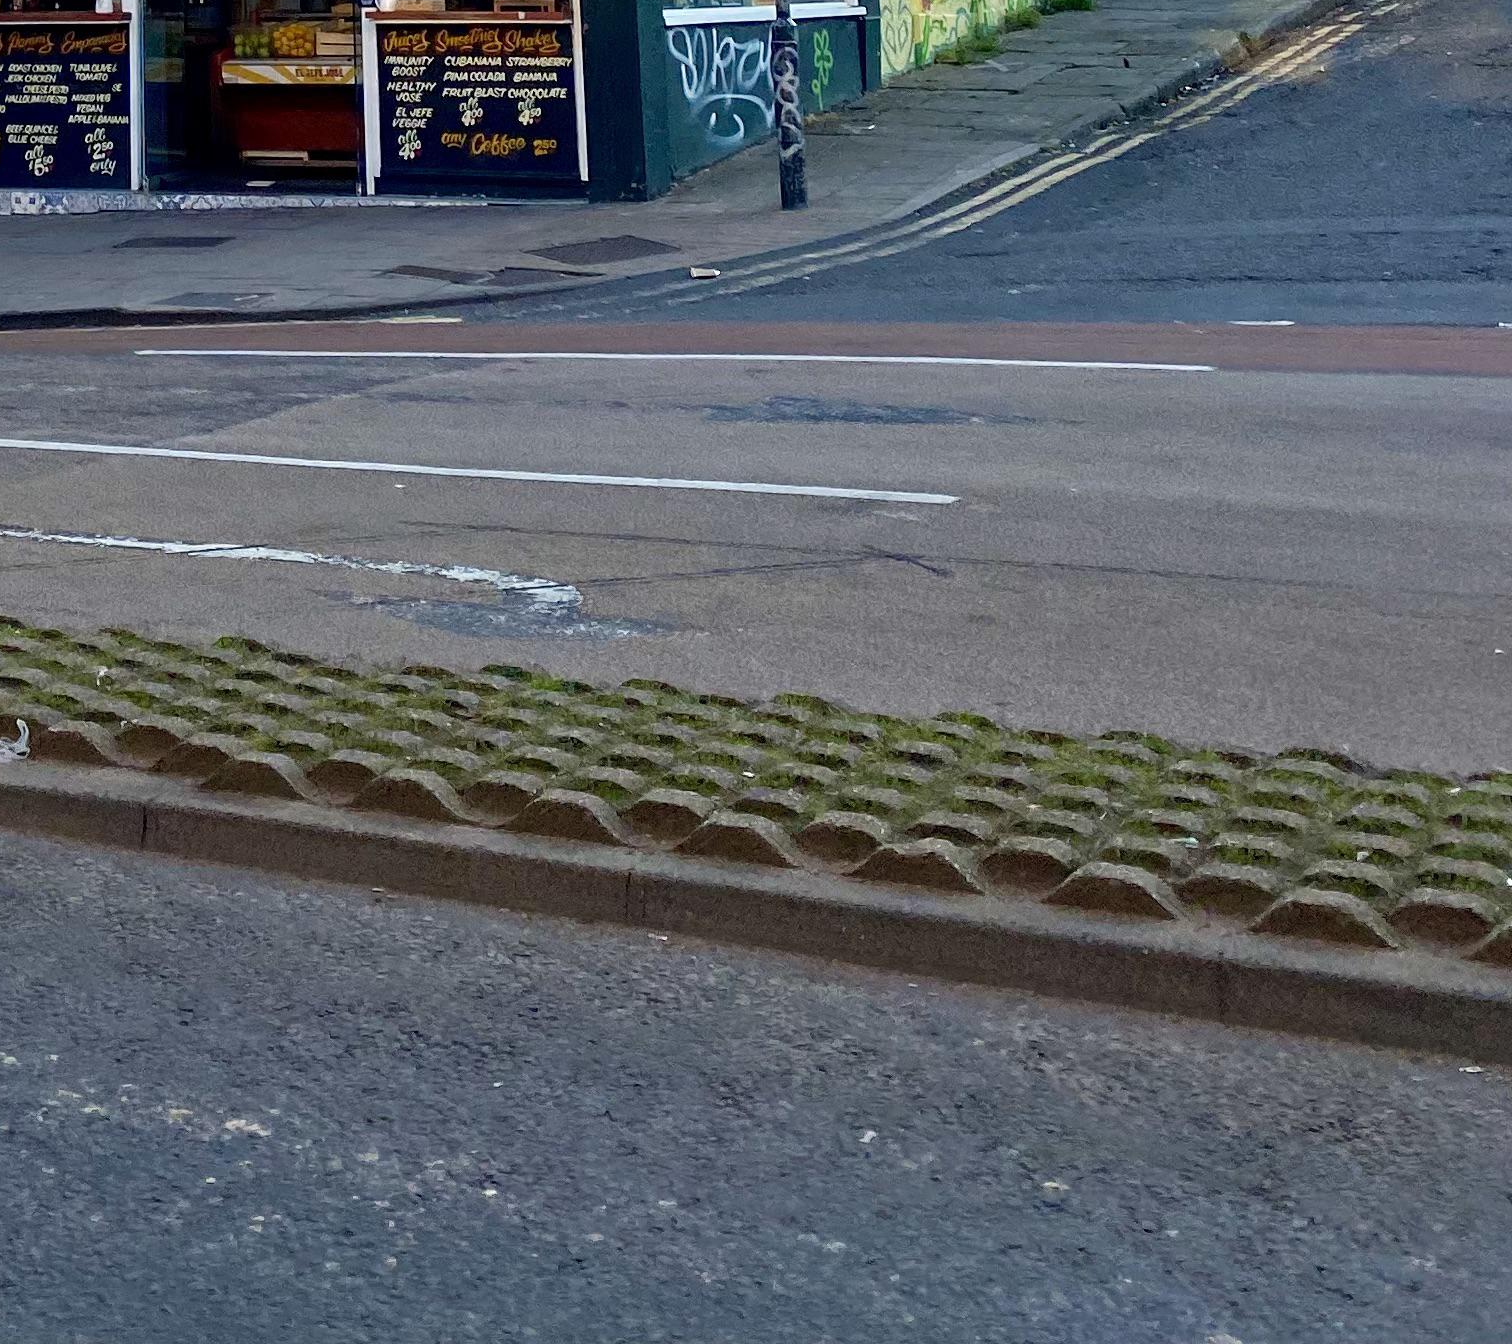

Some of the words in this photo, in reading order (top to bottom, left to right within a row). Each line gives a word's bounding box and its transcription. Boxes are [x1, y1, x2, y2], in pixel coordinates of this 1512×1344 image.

[384, 56, 434, 66] IMMUNITY
[444, 56, 501, 67] CUBANANA
[506, 56, 572, 67] STRAWBERRY
[391, 66, 426, 76] BOOST
[470, 71, 505, 81] COLADA
[4, 74, 24, 83] JERK
[25, 74, 56, 83] CHICKEN
[75, 73, 108, 81] TOMATO
[513, 72, 557, 82] BANANA
[387, 81, 436, 92] HEALTHY
[442, 88, 474, 97] FRUIT
[474, 87, 507, 98] BLAST
[508, 88, 567, 99] CHOCOLATE
[395, 107, 407, 117] EL
[410, 107, 433, 118] JEFE
[392, 118, 428, 128] VEGGIE
